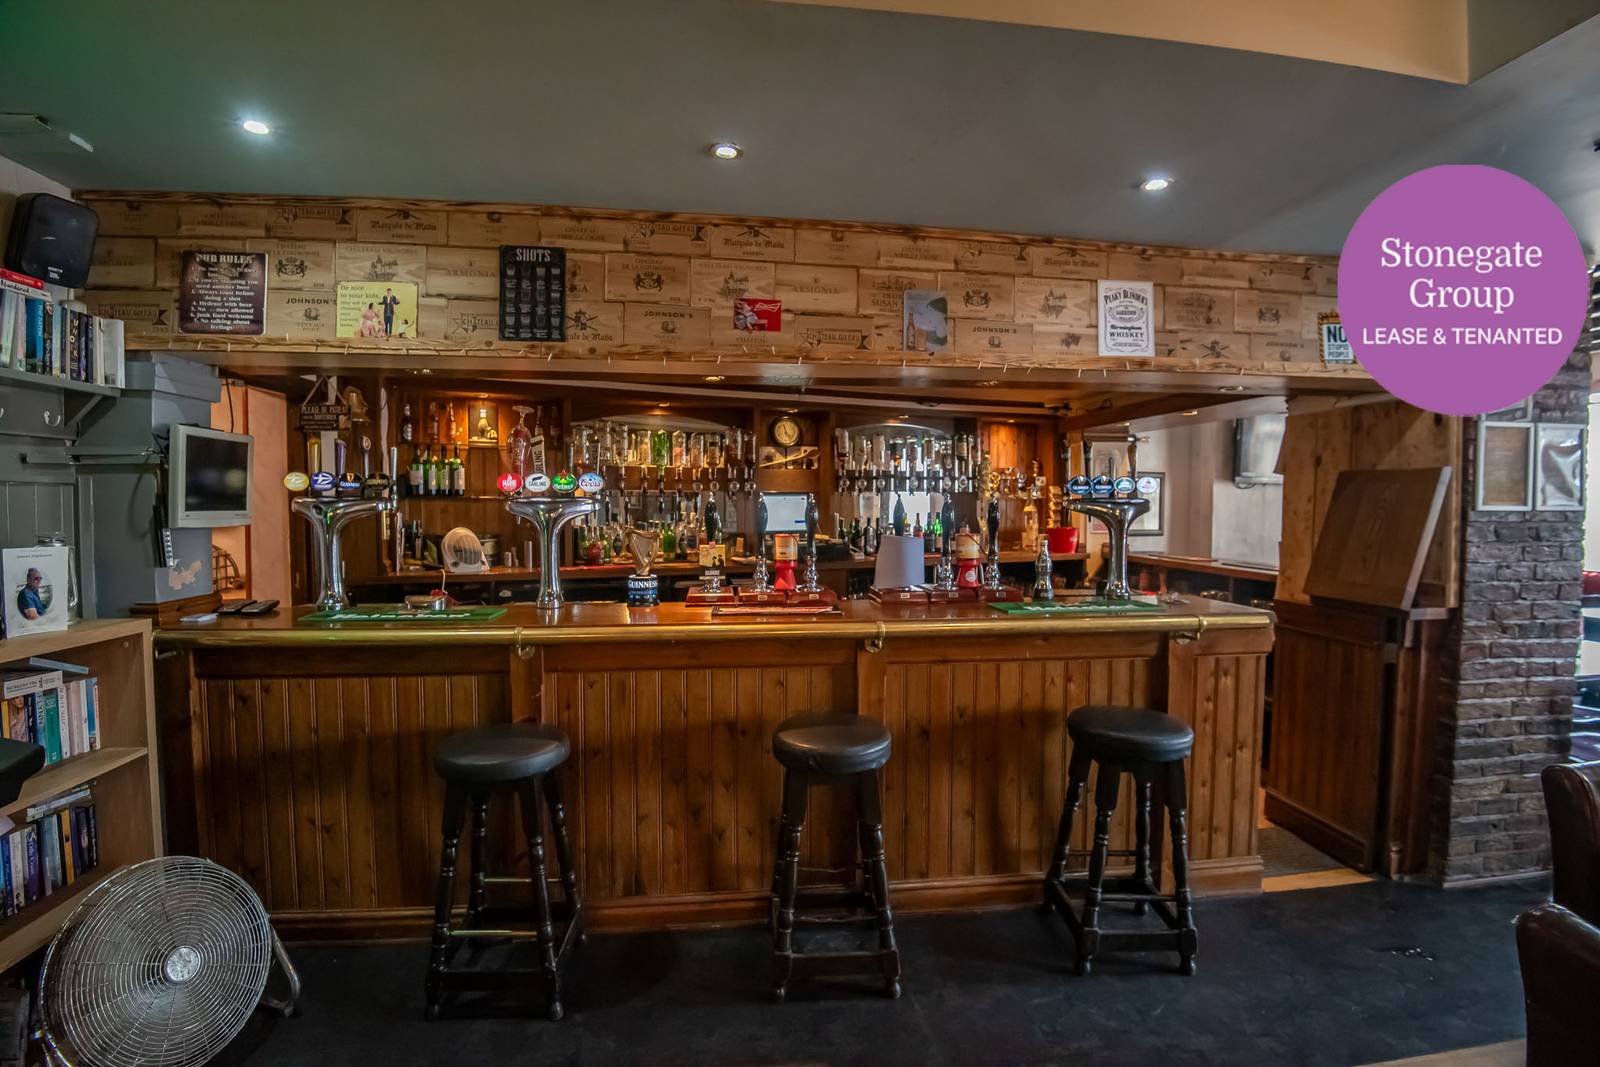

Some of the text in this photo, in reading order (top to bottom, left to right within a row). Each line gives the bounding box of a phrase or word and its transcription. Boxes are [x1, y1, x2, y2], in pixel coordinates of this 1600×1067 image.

[195, 254, 218, 262] PUB
[516, 248, 551, 262] SHOTS
[1104, 290, 1148, 306] PEAKY BLINDERS
[643, 310, 693, 319] JOHNSON'S
[972, 326, 1017, 334] JOHNSON'S
[1327, 325, 1348, 343] NO
[580, 480, 601, 488] Coors
[628, 580, 658, 589] GUINNESS
